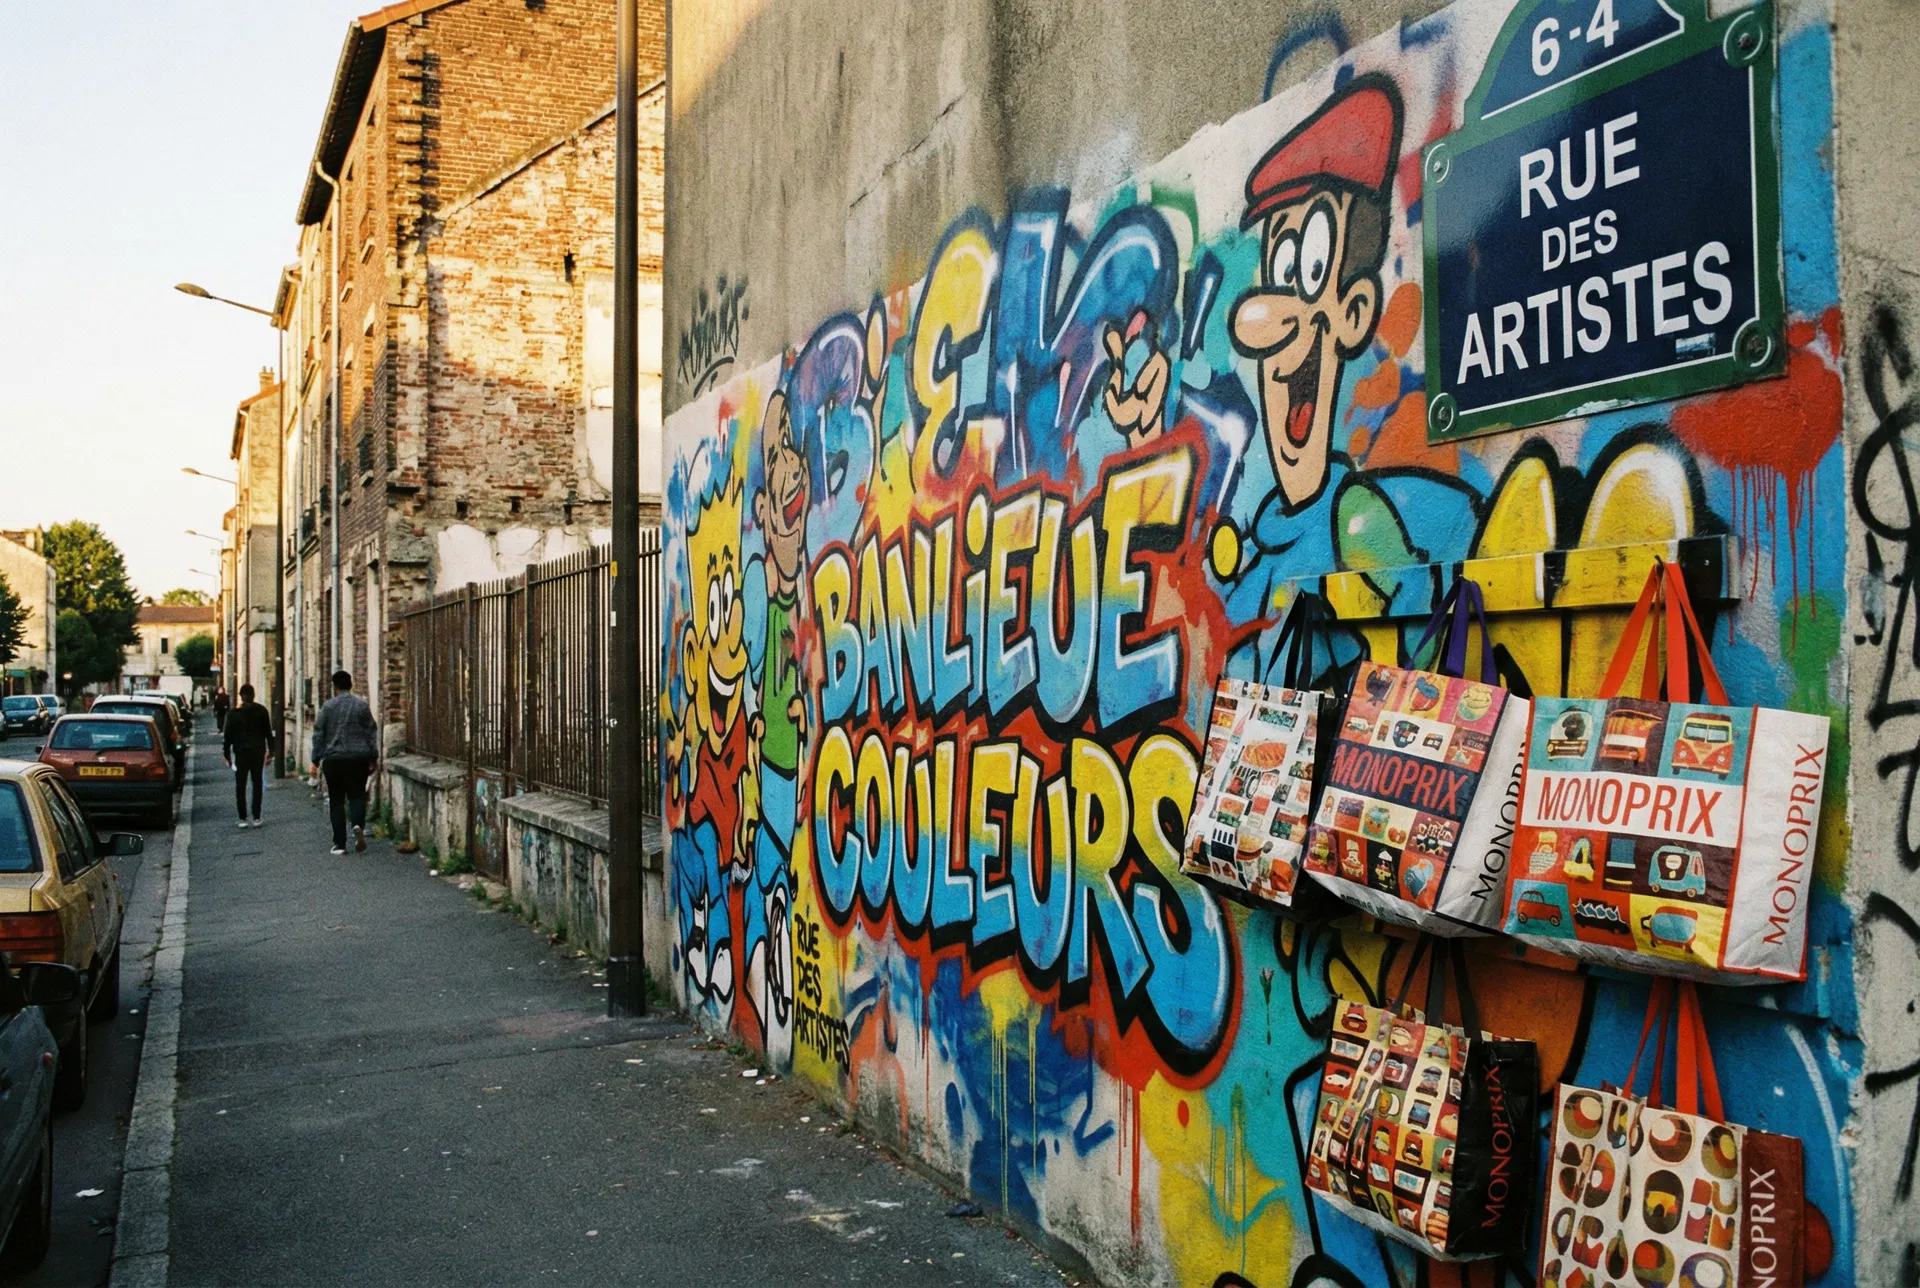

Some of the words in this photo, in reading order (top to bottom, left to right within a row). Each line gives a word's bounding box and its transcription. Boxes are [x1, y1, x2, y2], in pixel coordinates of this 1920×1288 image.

[1531, 0, 1620, 77] 6-4
[1519, 111, 1641, 219] RUE
[1542, 208, 1619, 271] DES
[1456, 240, 1733, 385] ARTISTES
[1331, 743, 1469, 815] MONOPRIX
[1536, 776, 1723, 838] MONOPRIX
[1761, 743, 1825, 946] MONOPRIX
[813, 723, 1238, 1061] COULEURS
[794, 912, 821, 960] RUE
[796, 955, 823, 1008] DES
[1481, 1064, 1513, 1228] MONOPRIX
